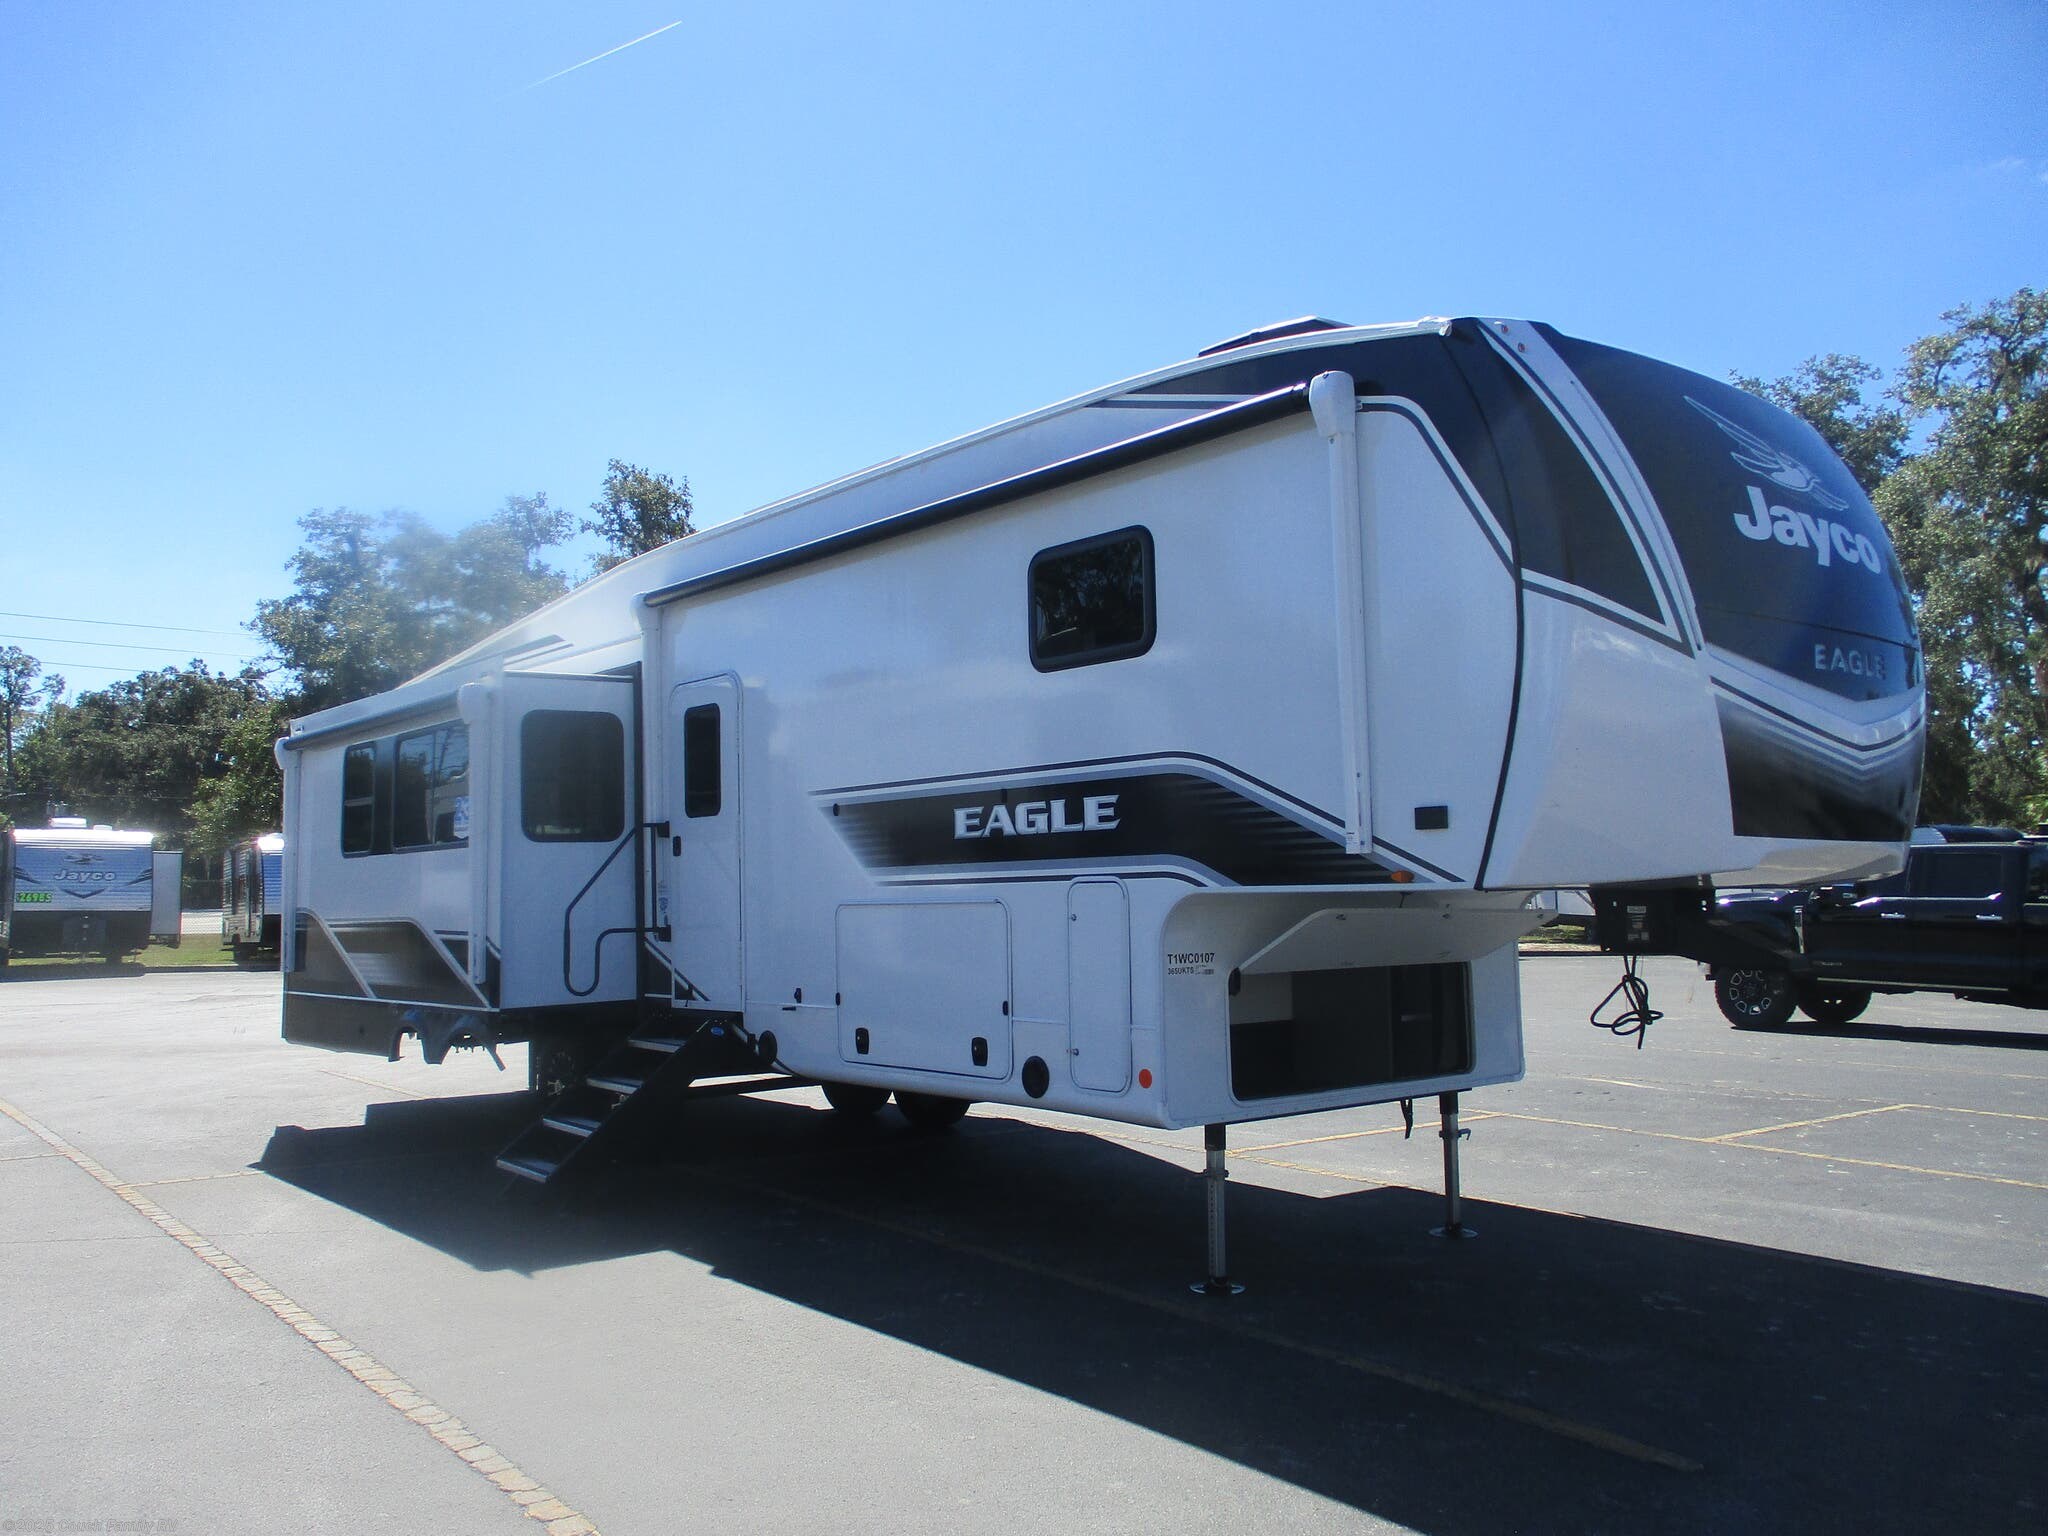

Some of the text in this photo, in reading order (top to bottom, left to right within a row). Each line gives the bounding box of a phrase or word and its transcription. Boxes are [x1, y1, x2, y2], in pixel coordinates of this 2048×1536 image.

[1733, 486, 1881, 574] Jayco
[1814, 644, 1887, 680] EAGLE
[953, 794, 1120, 840] EAGLE
[53, 869, 117, 883] Jayco
[1167, 952, 1216, 965] T1WC0107
